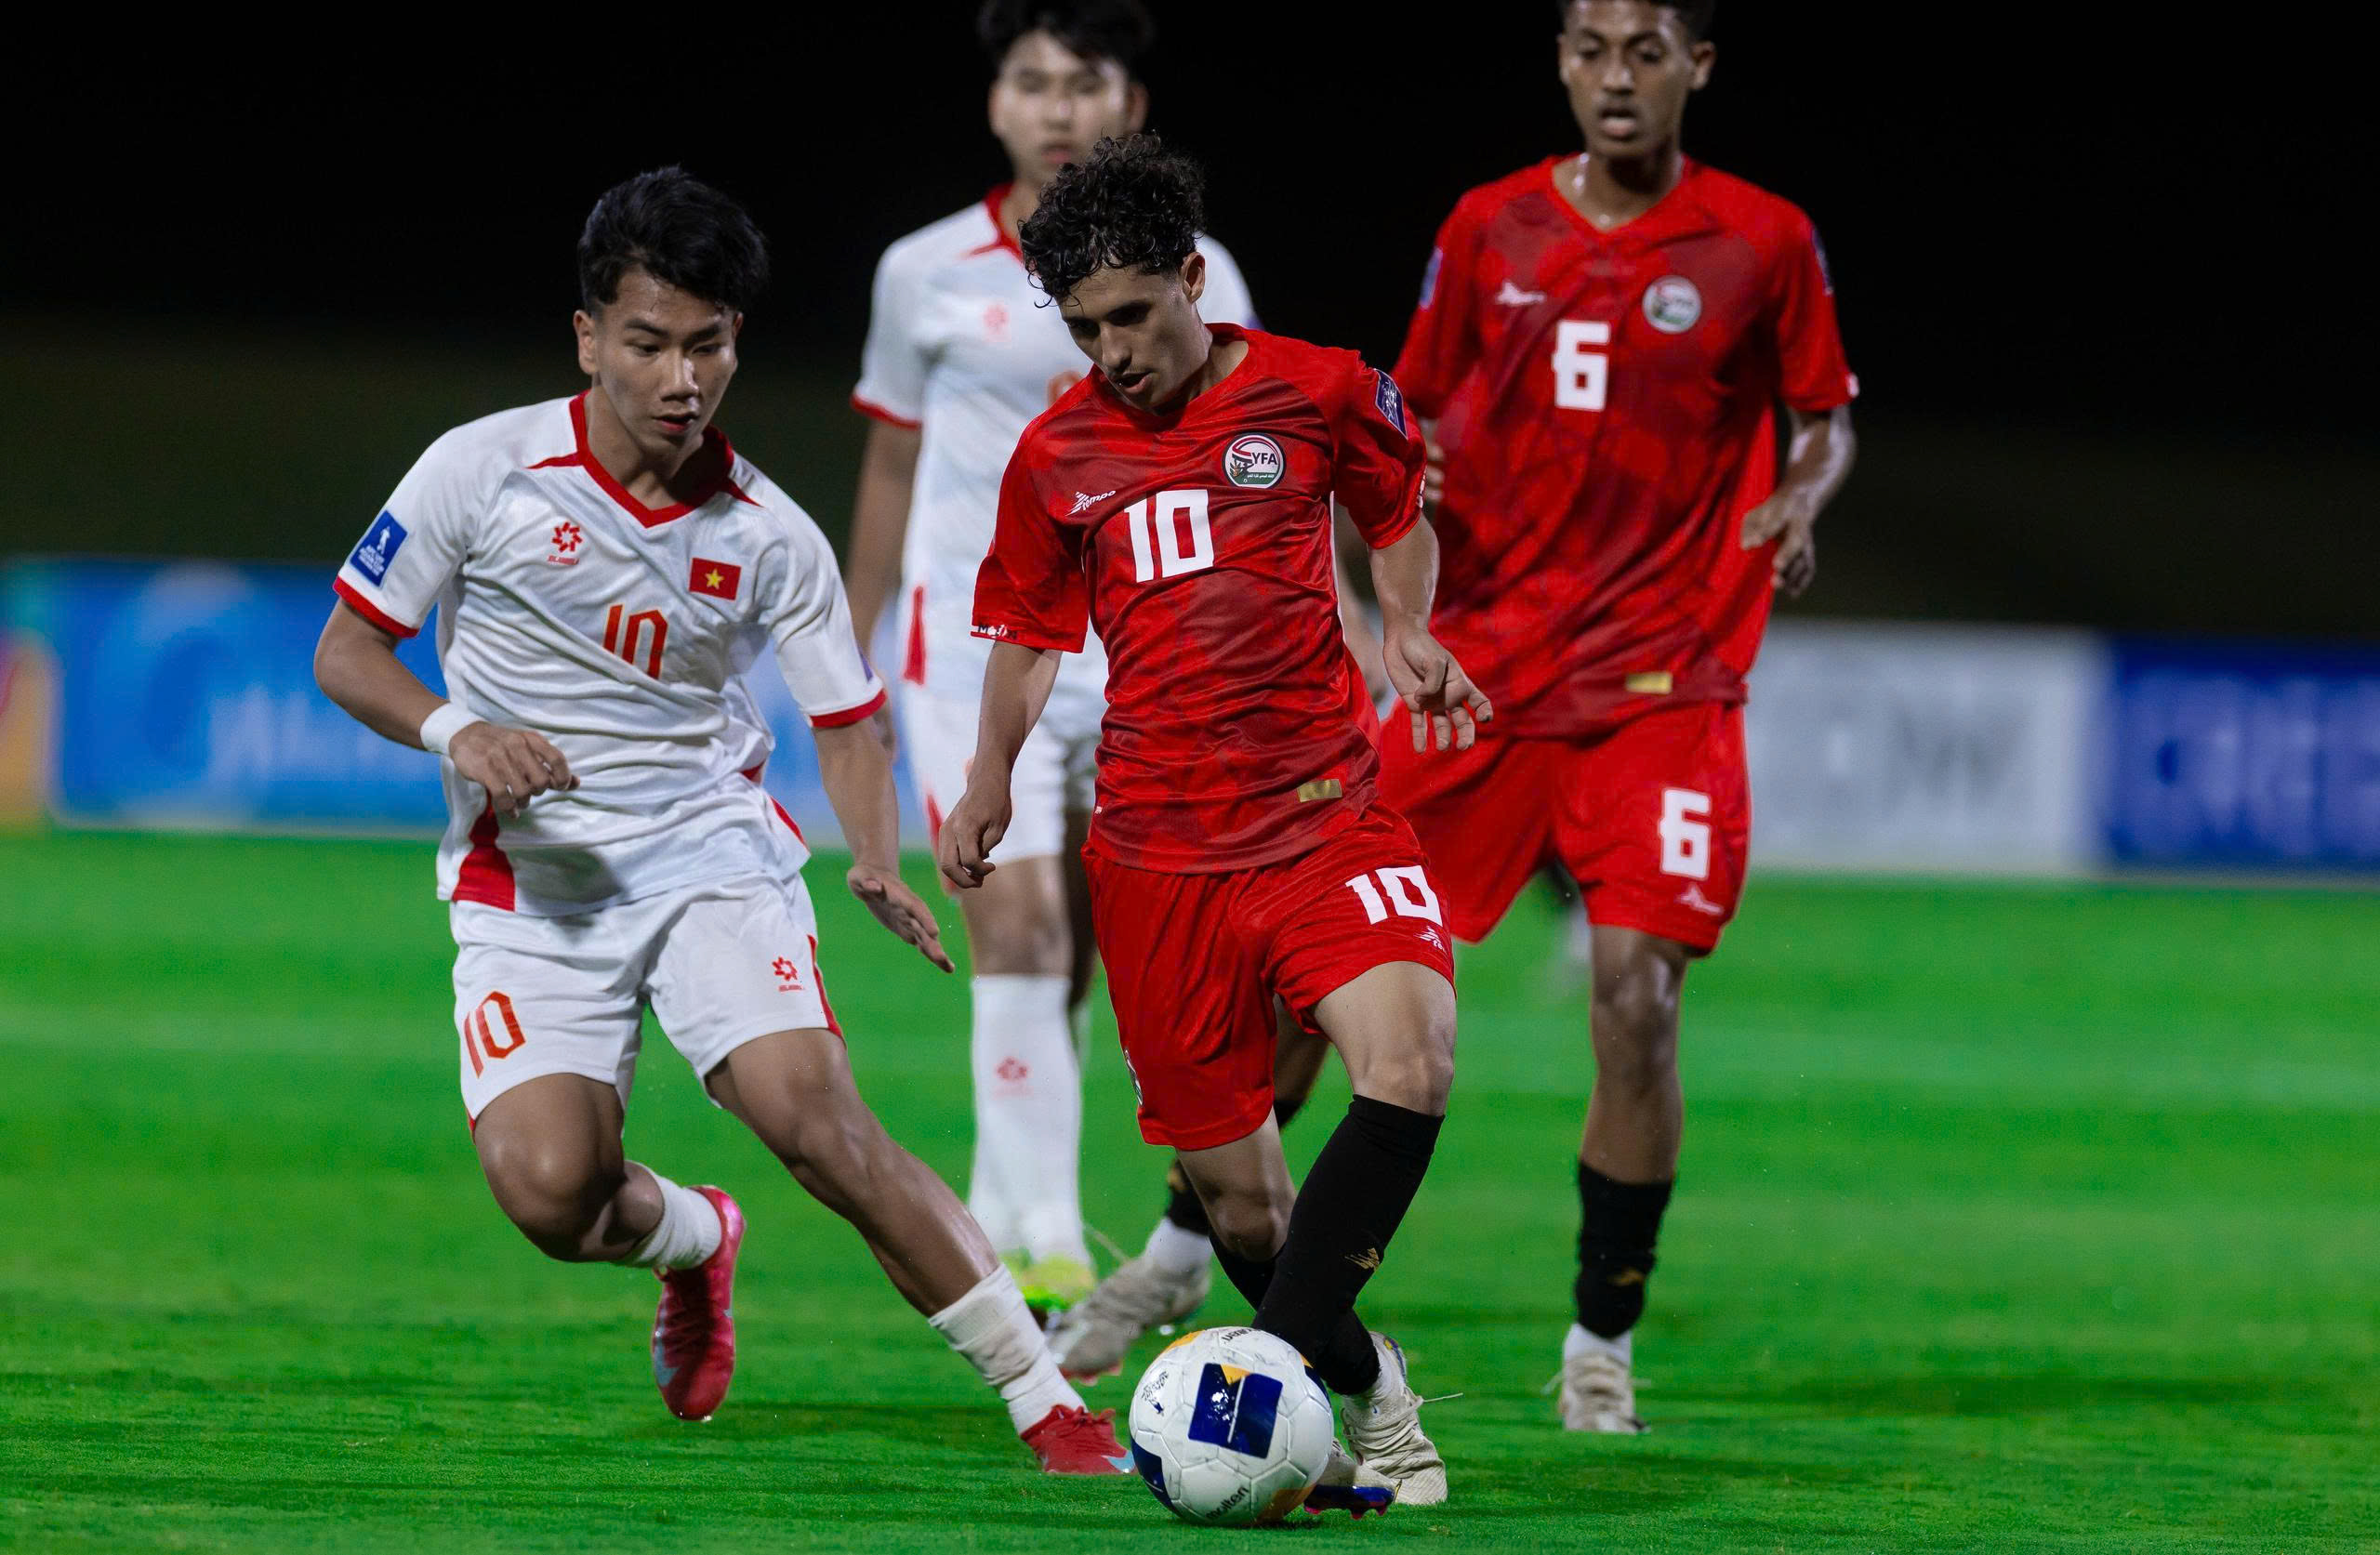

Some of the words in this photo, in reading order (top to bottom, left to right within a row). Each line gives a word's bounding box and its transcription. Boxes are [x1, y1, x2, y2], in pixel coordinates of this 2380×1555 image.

[1552, 320, 1611, 411] 6
[1251, 452, 1278, 465] YFA
[1124, 489, 1214, 583] 10
[602, 603, 668, 680] 10
[1659, 788, 1712, 880] 6
[1345, 864, 1444, 927] 10
[463, 990, 526, 1079] 10
